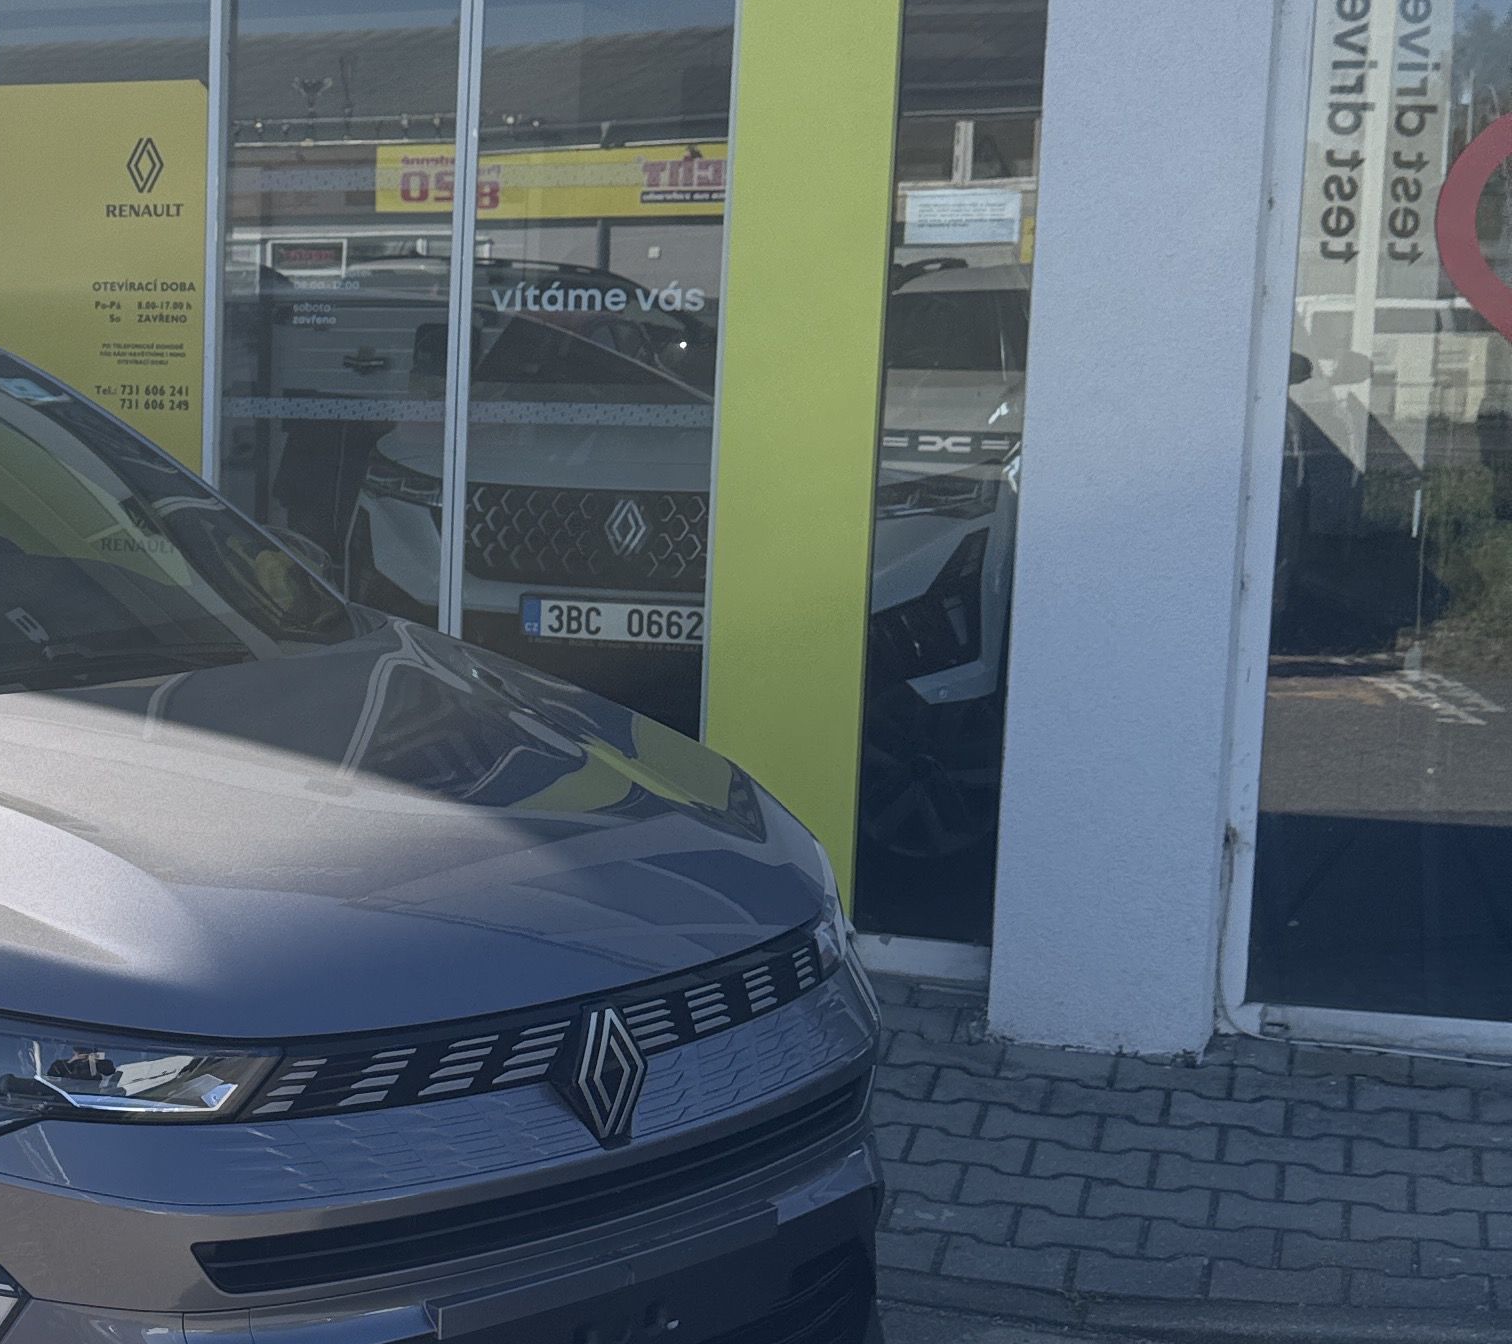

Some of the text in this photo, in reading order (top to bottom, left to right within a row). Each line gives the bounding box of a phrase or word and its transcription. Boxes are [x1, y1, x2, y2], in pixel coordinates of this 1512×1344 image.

[105, 203, 184, 218] RENAULT
[92, 278, 196, 292] OTEVÍRACÍ DOBA
[490, 280, 705, 312] vítáme vás
[137, 313, 187, 323] ZAVŘENO
[120, 384, 140, 396] 731
[144, 385, 166, 396] 606
[169, 385, 189, 397] 241
[120, 398, 139, 410] 731
[144, 399, 165, 410] 606
[524, 604, 704, 641] CZ 3BC 0662
